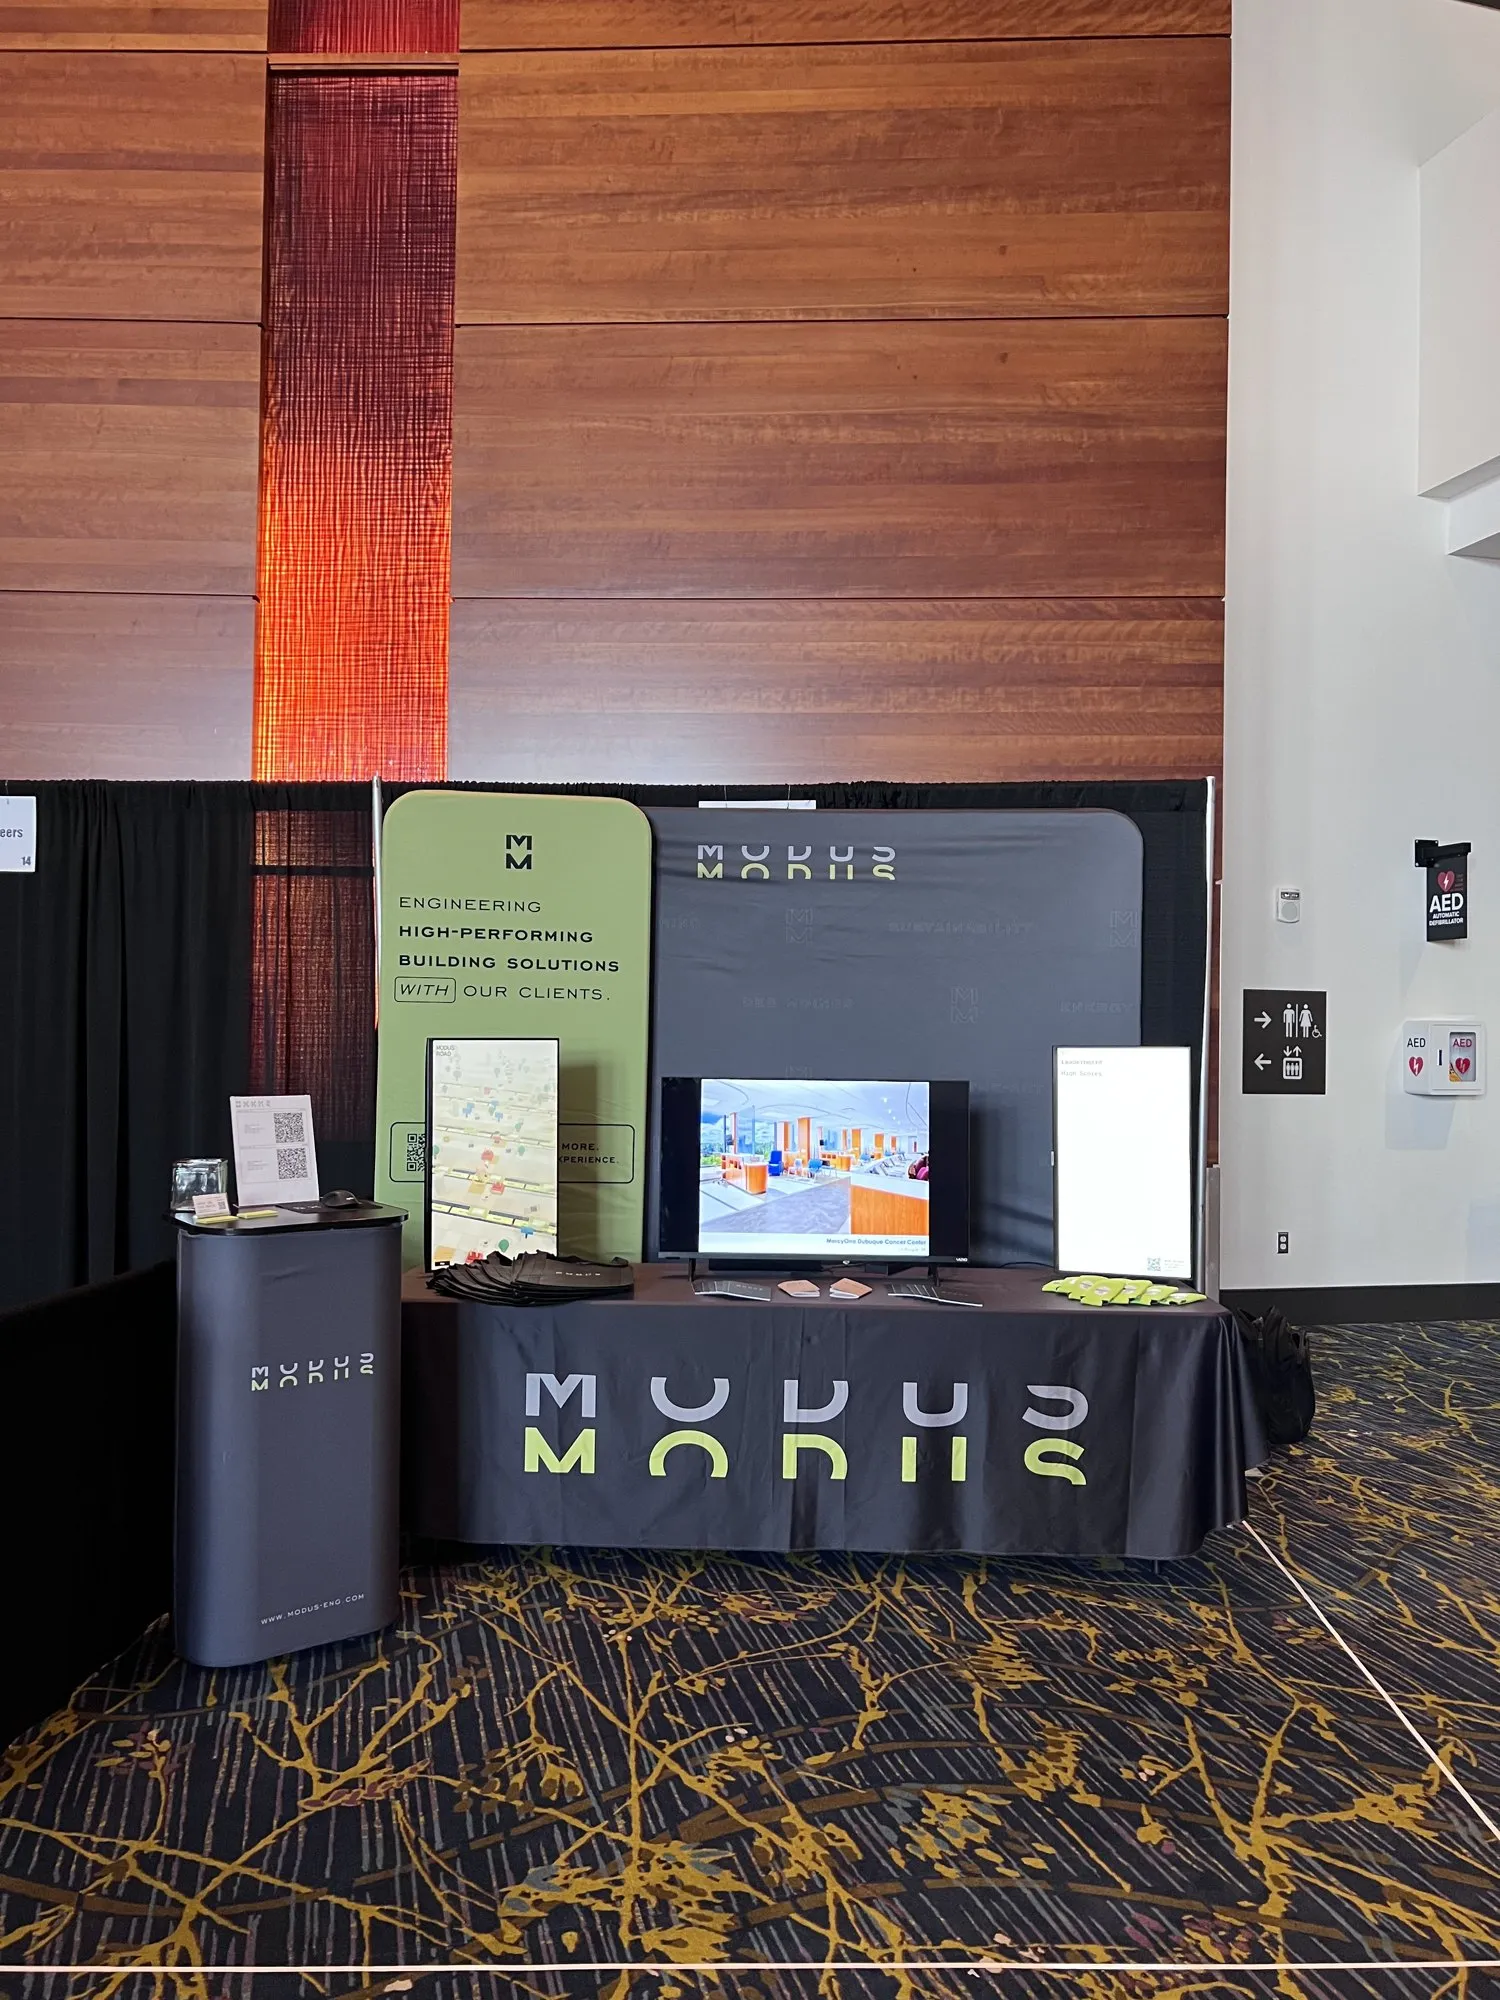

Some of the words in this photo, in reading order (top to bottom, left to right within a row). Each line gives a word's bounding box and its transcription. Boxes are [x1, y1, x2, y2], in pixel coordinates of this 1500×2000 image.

[21, 856, 31, 866] 14
[399, 897, 541, 913] ENGINEERING
[1429, 893, 1464, 912] AED
[1433, 911, 1460, 919] AUTOMATIC
[1429, 918, 1464, 926] DEFIBRILLATOR
[399, 925, 593, 943] HIGH-PERFORMING
[399, 955, 496, 969] BUILDING
[507, 957, 619, 972] SOLUTIONS
[400, 984, 449, 997] WITH
[463, 985, 507, 998] OUR
[519, 987, 611, 1001] CLIENTS.
[1407, 1038, 1426, 1048] AED
[1453, 1038, 1473, 1048] AED
[561, 1143, 599, 1151] MORE.
[558, 1156, 619, 1164] XPERIENCE.
[826, 1238, 857, 1246] MercyOne
[858, 1238, 883, 1246] Dubuque
[260, 1593, 365, 1625] WWW.MODUS-ENG.COM
